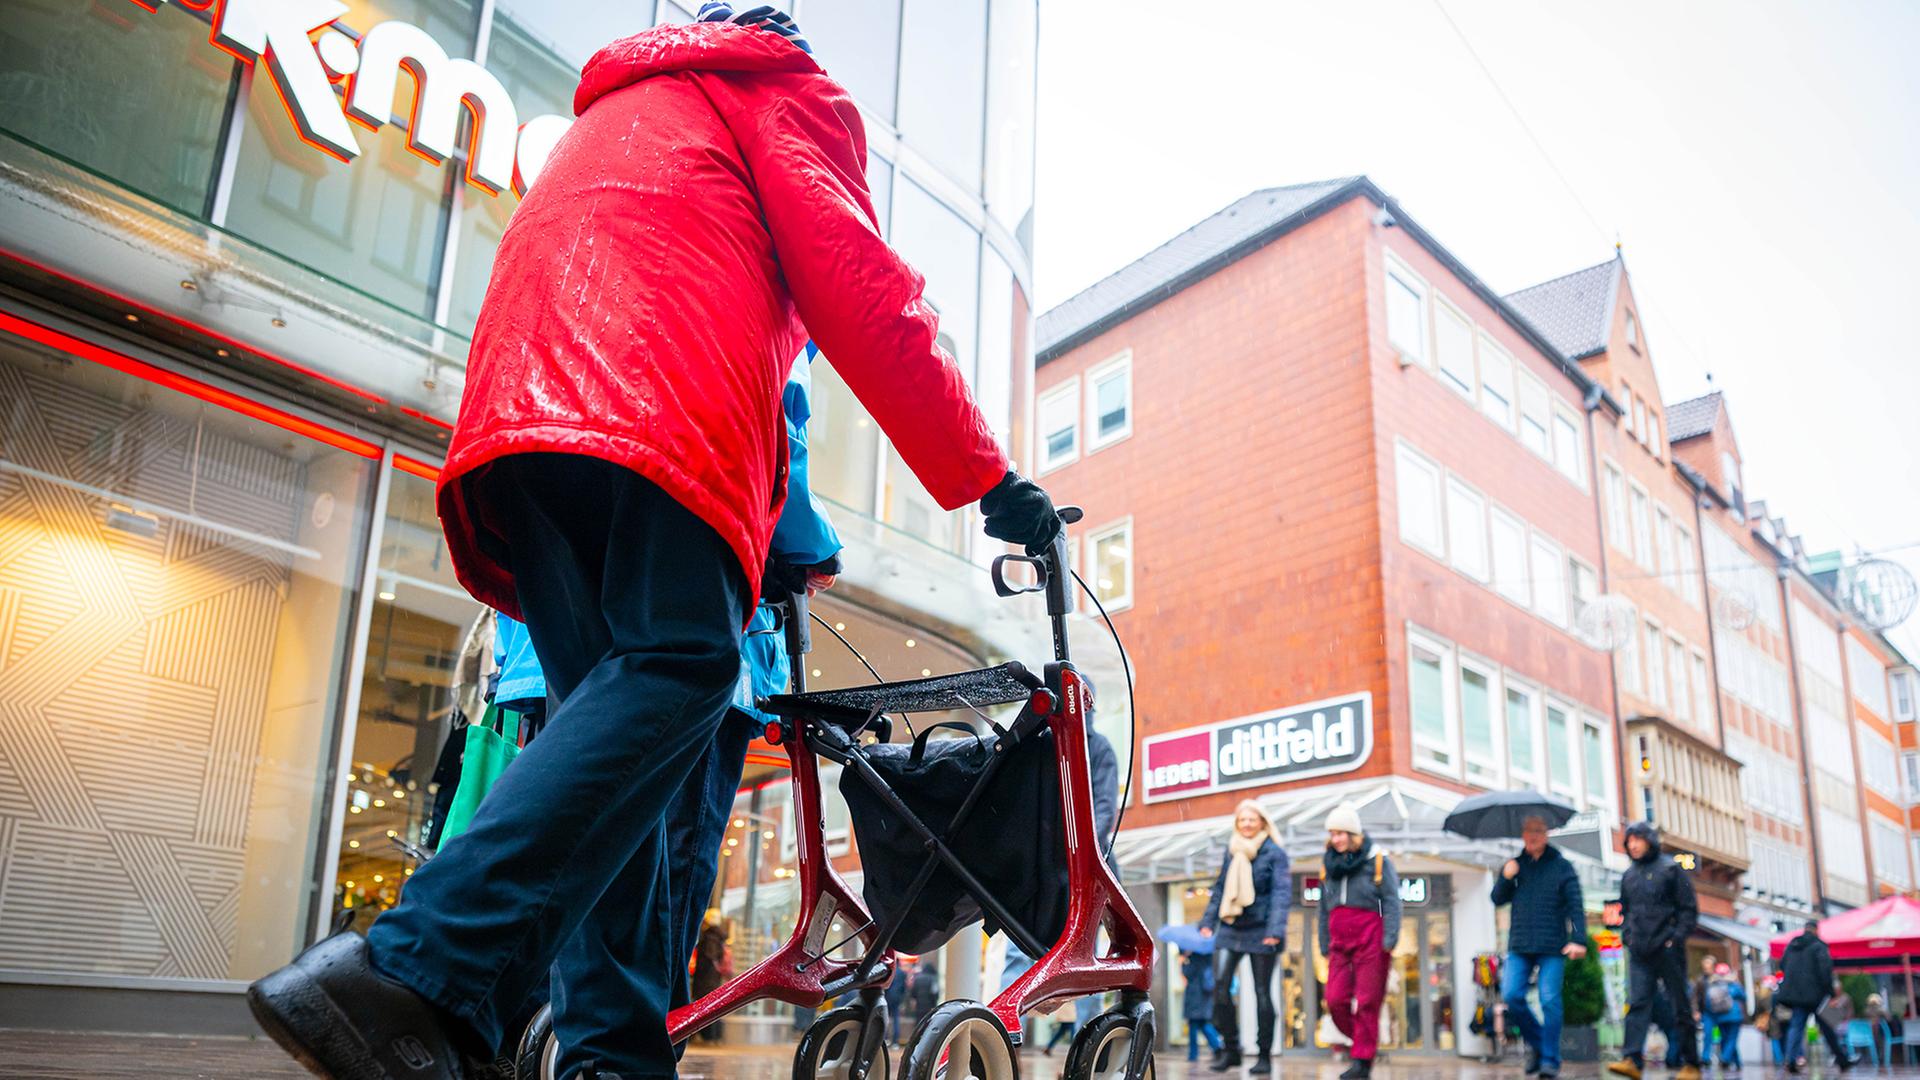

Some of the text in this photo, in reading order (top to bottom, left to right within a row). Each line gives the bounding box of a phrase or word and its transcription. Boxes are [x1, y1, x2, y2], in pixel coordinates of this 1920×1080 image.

[1067, 684, 1076, 714] TOPRO
[1144, 706, 1355, 789] LEDER dittfeld
